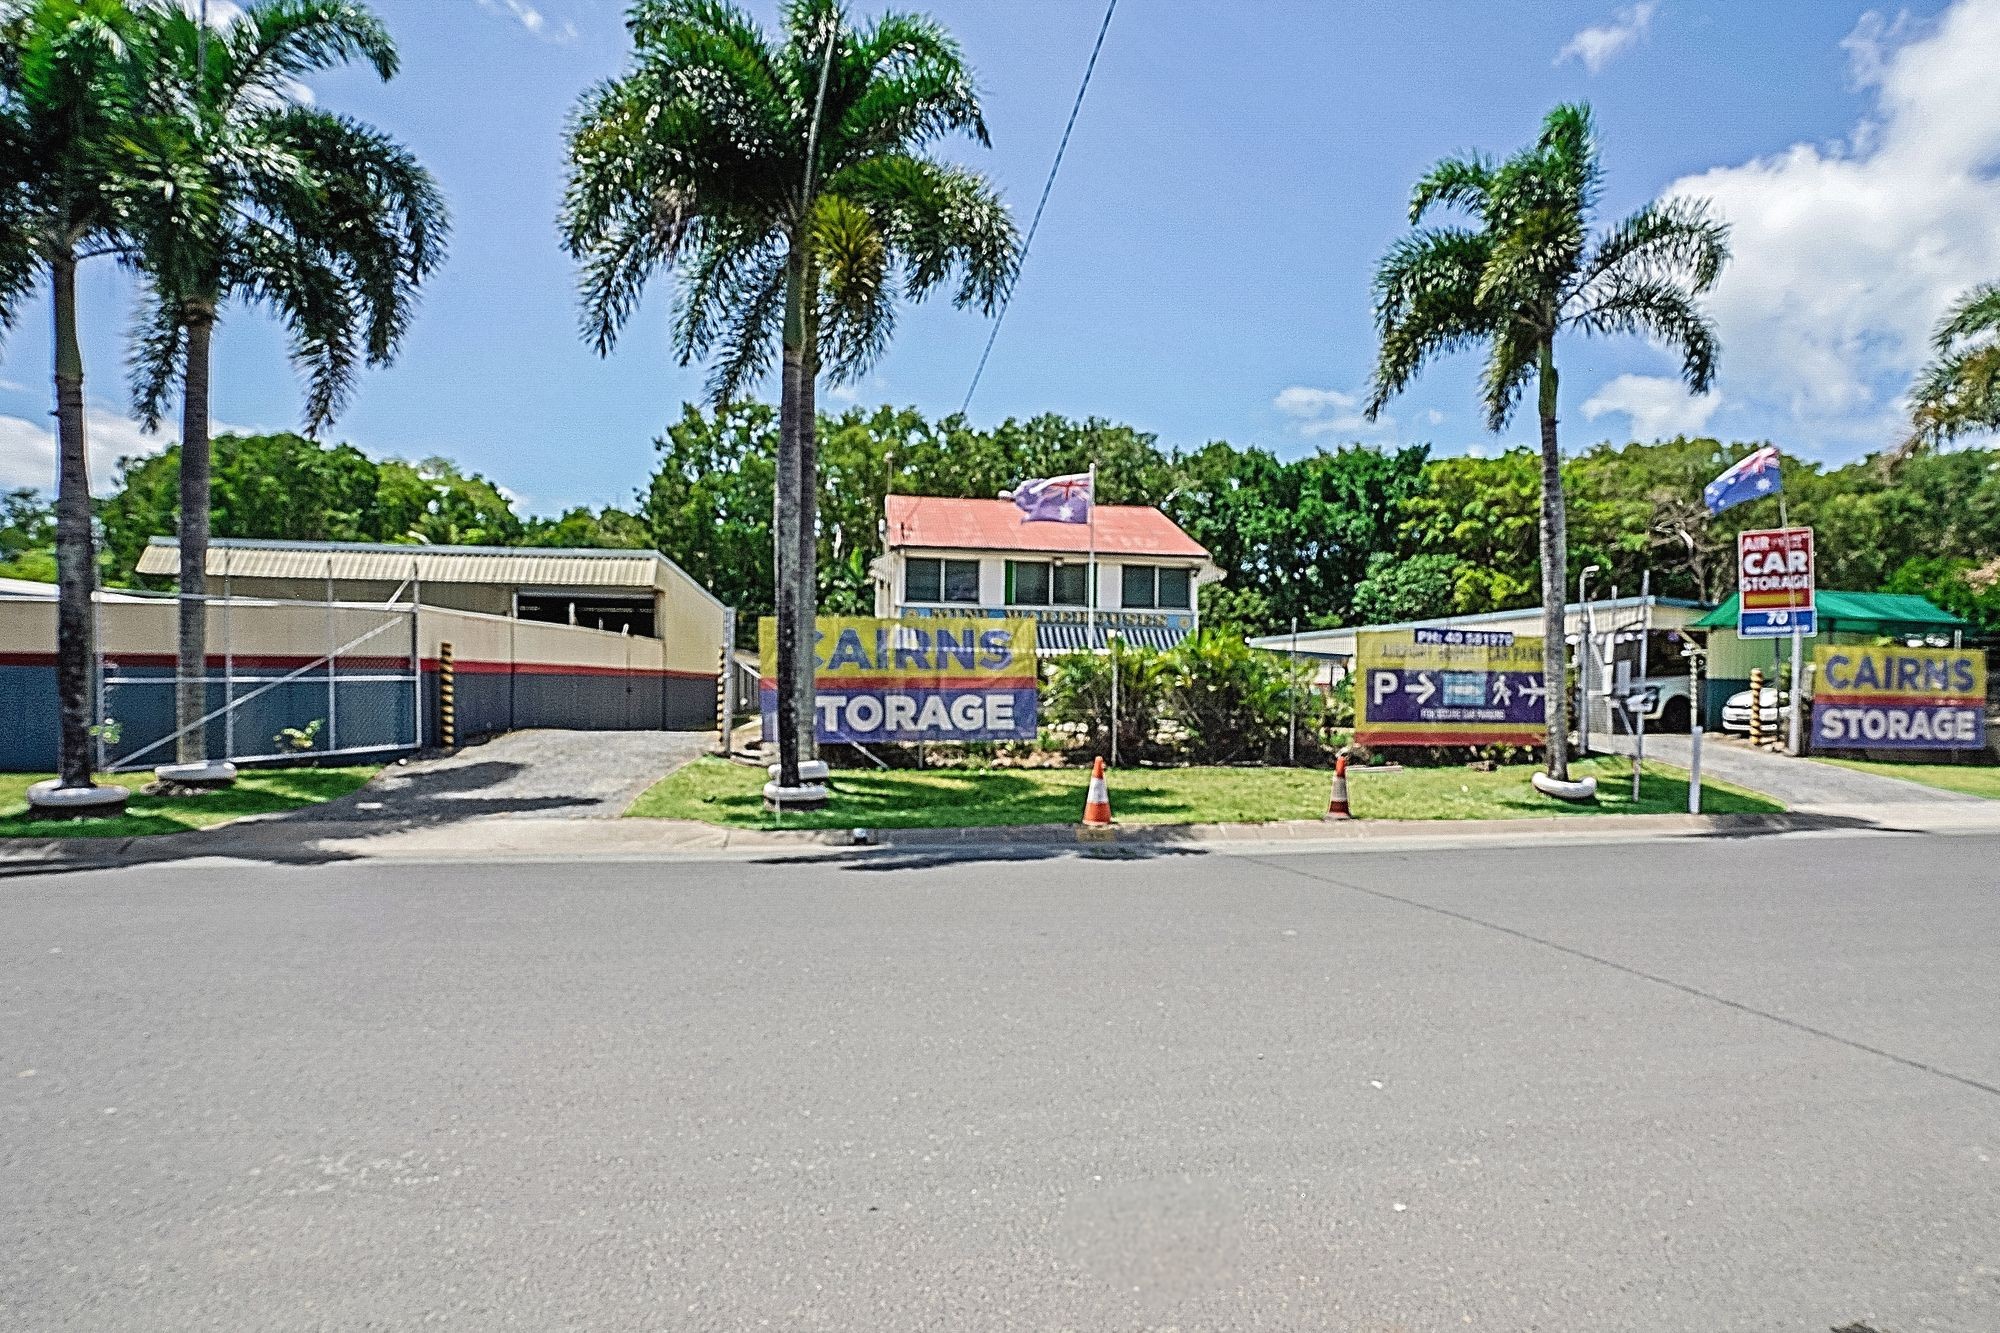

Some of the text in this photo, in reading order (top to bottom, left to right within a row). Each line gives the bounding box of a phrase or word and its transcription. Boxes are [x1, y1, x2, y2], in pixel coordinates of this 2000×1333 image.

[1743, 550, 1808, 575] CAR
[1742, 574, 1809, 592] STORAGE
[1767, 611, 1789, 625] 70
[815, 628, 1013, 671] AIRNS
[1825, 655, 1974, 692] CAIRNS
[814, 694, 1015, 732] TORAGE
[1820, 708, 1975, 741] STORAGE
